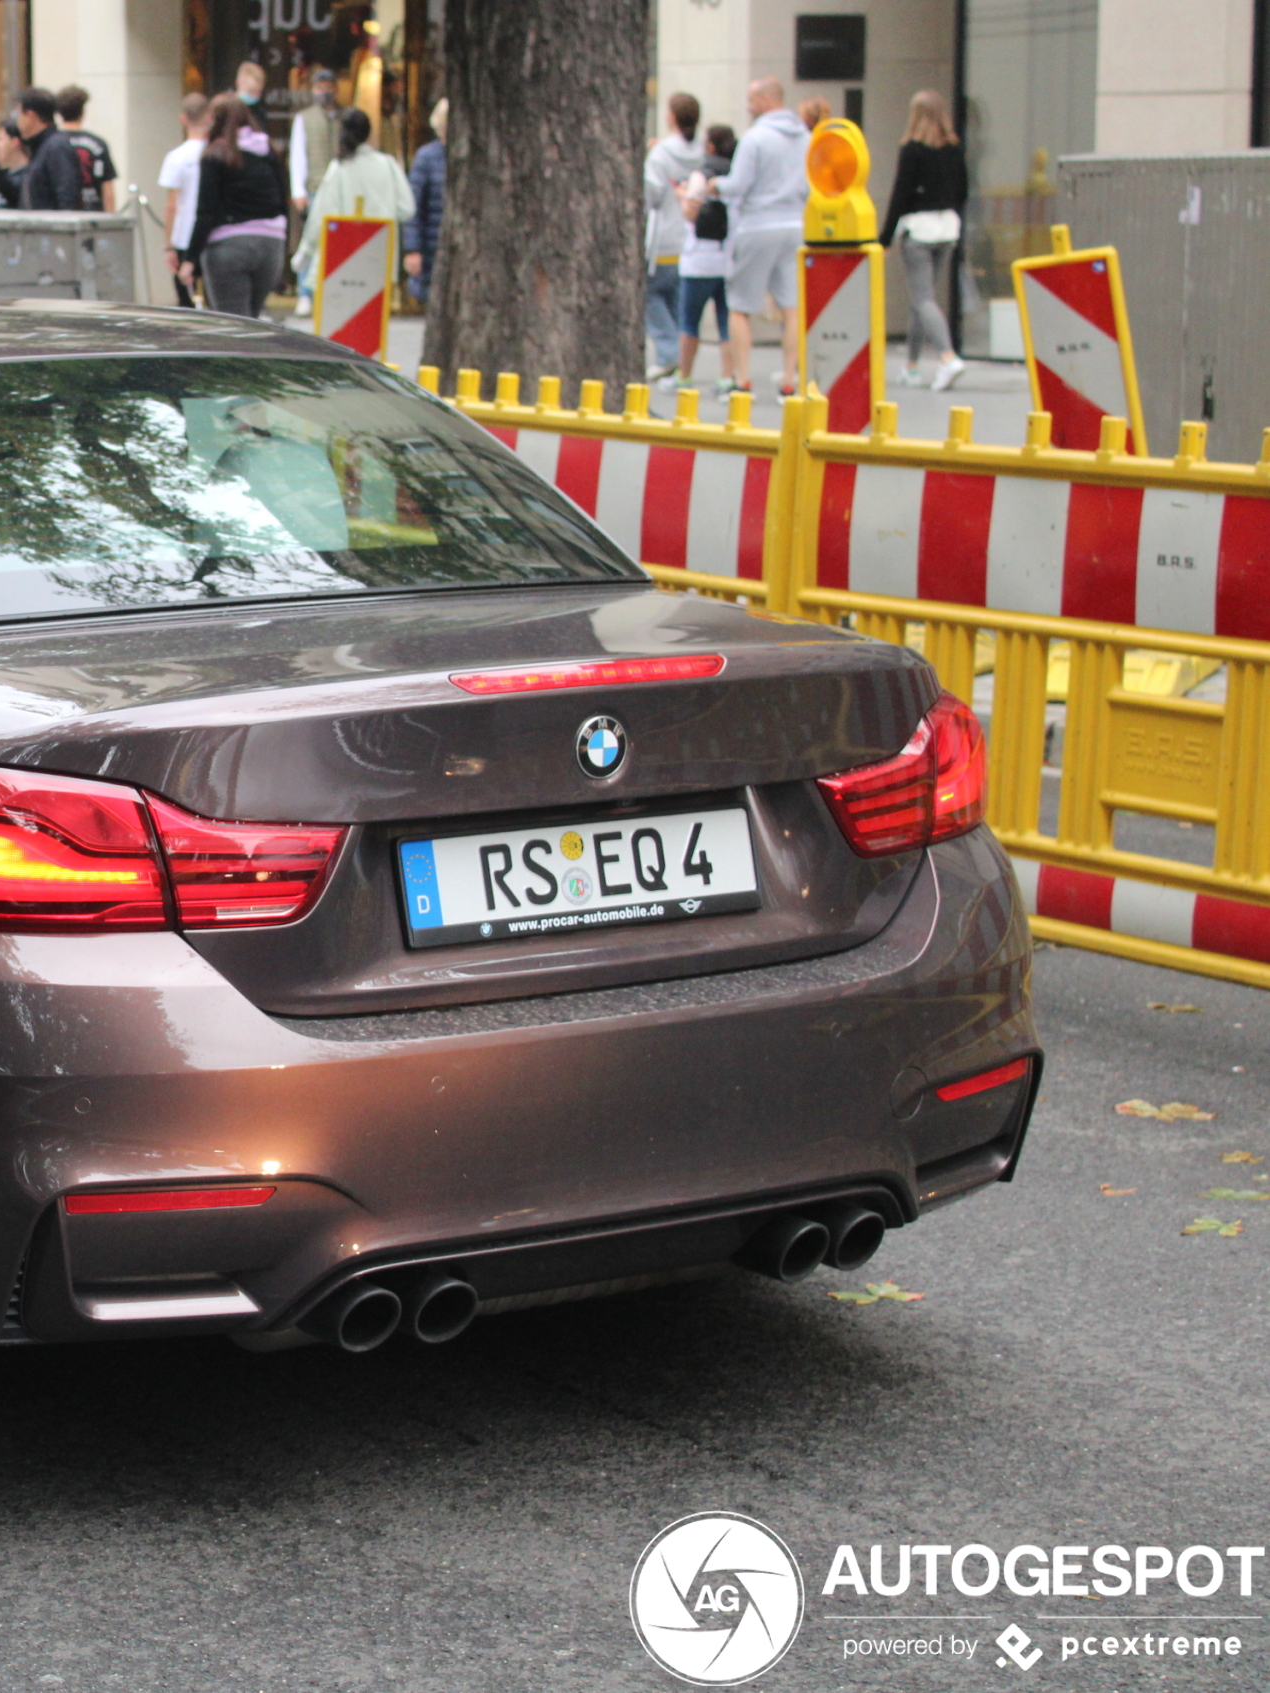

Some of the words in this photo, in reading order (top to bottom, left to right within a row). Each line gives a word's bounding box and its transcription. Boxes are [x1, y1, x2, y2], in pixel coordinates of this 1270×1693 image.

[582, 718, 623, 740] BMW
[479, 839, 559, 911] RS
[593, 827, 668, 897] EQ
[683, 822, 713, 886] 4
[417, 895, 431, 914] D
[509, 903, 664, 932] www.procar-automobile.de
